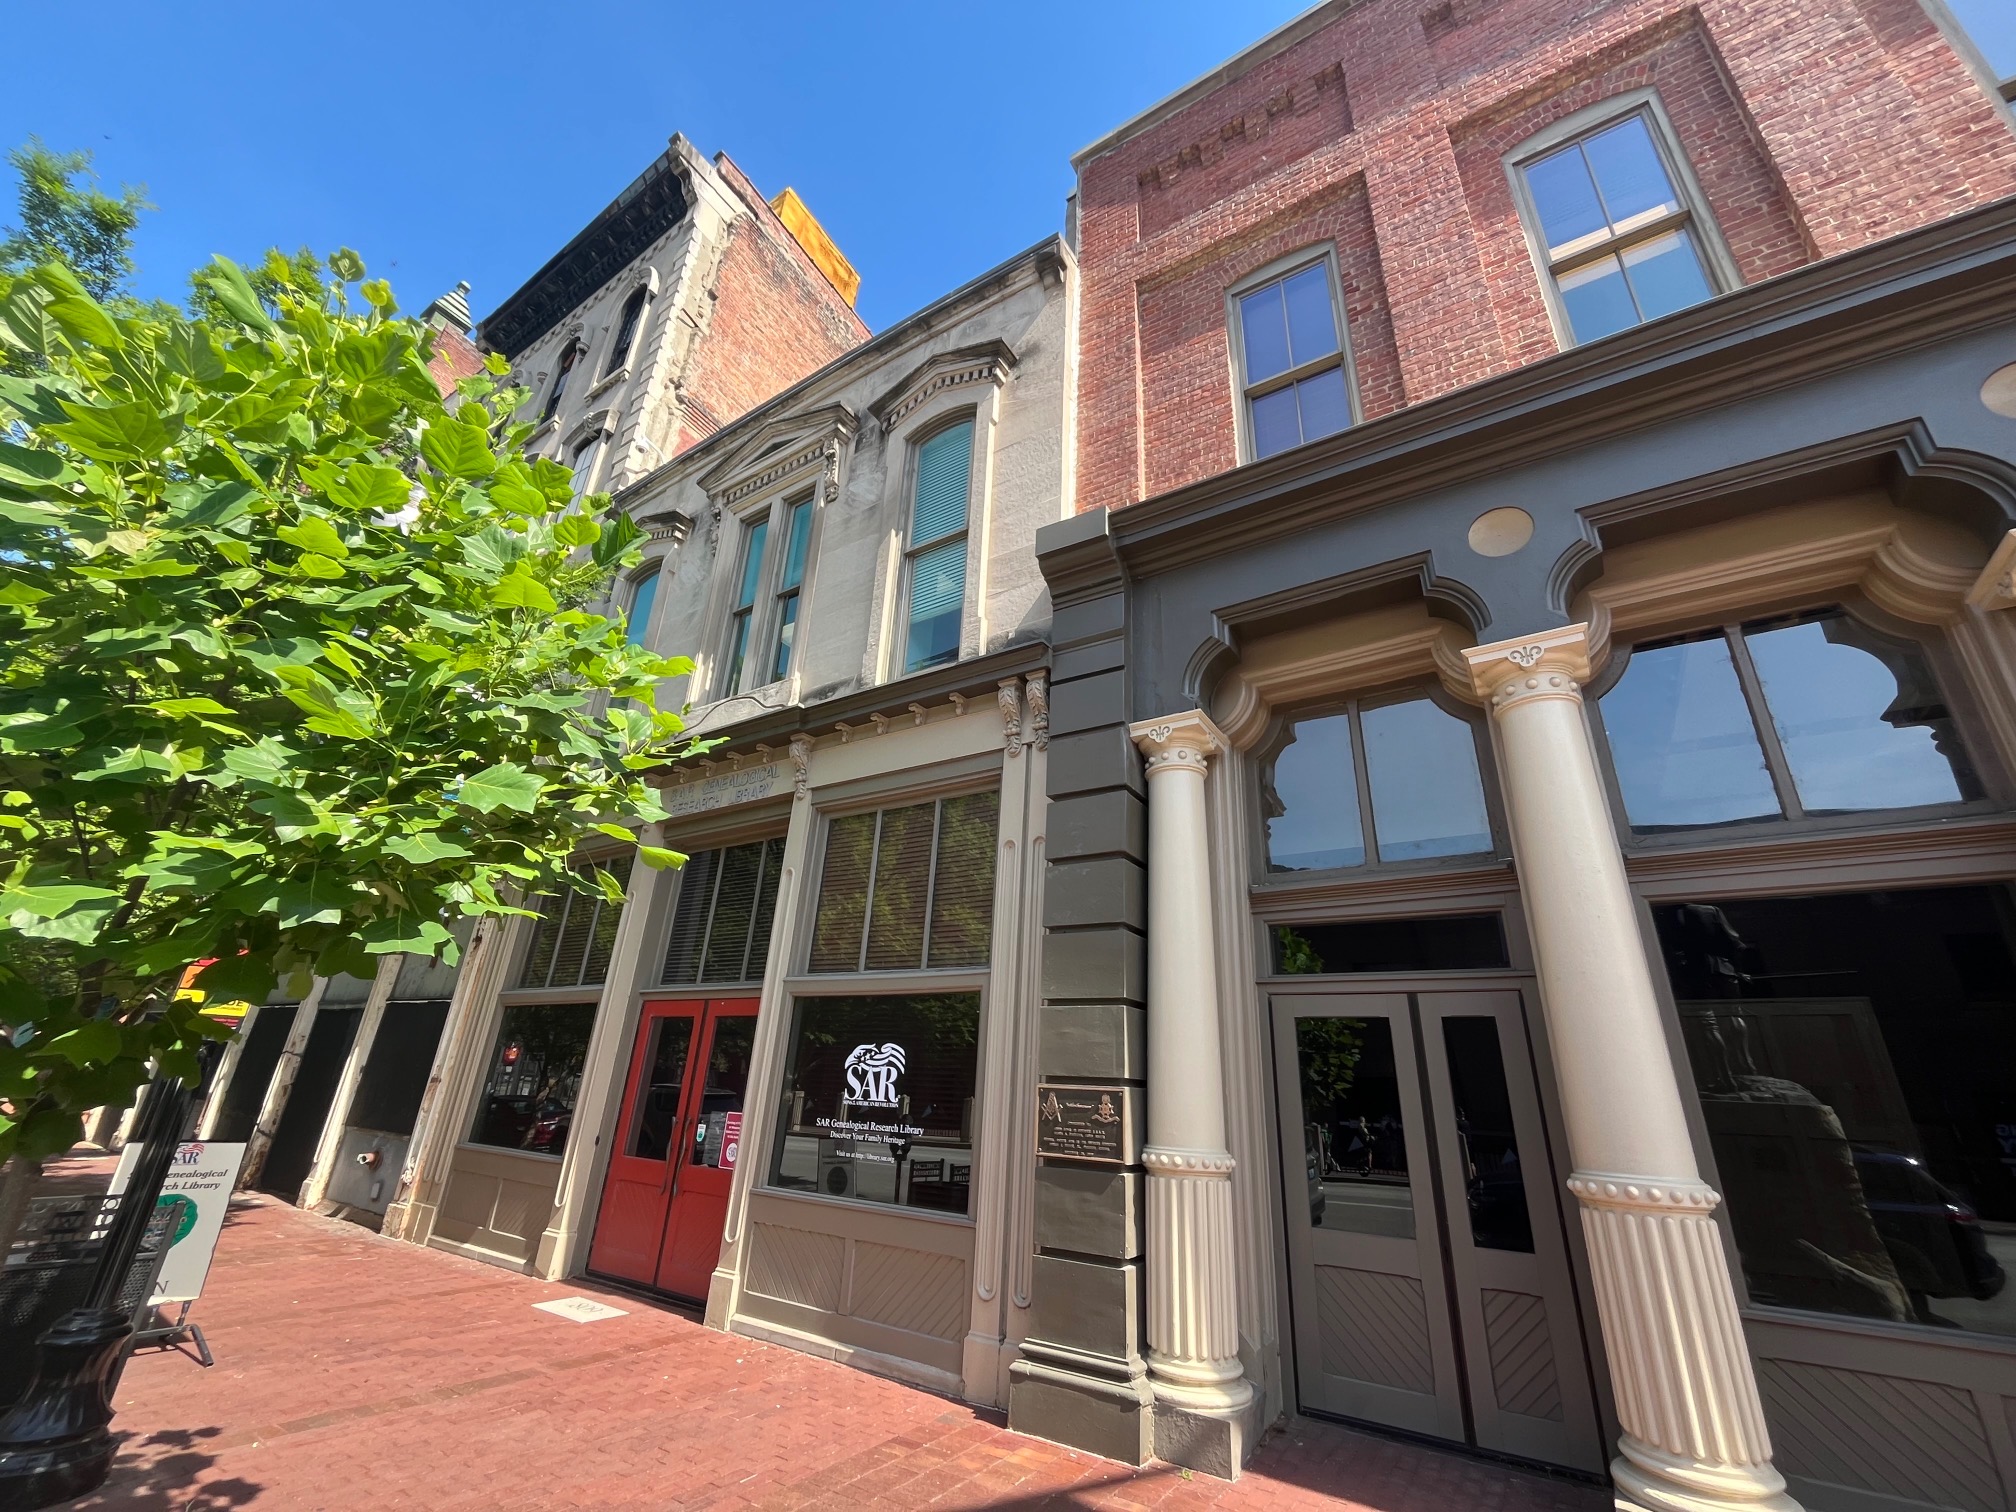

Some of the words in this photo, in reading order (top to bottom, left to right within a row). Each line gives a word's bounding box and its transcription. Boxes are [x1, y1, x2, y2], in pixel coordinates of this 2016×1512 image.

[670, 784, 695, 802] SAR
[702, 763, 780, 795] GENEALOGICAL
[671, 794, 722, 816] RESEARCH
[728, 781, 774, 805] LIBRARY
[844, 1065, 899, 1103] SAR
[816, 1117, 831, 1127] SAR
[831, 1118, 870, 1132] Genealogical
[870, 1121, 899, 1133] Research
[899, 1123, 925, 1136] Library
[830, 1130, 852, 1139] Discover
[852, 1132, 864, 1141] Your
[864, 1133, 882, 1143] Family
[883, 1135, 906, 1146] Heritage
[166, 1169, 229, 1180] enealogical
[181, 1181, 221, 1191] Library
